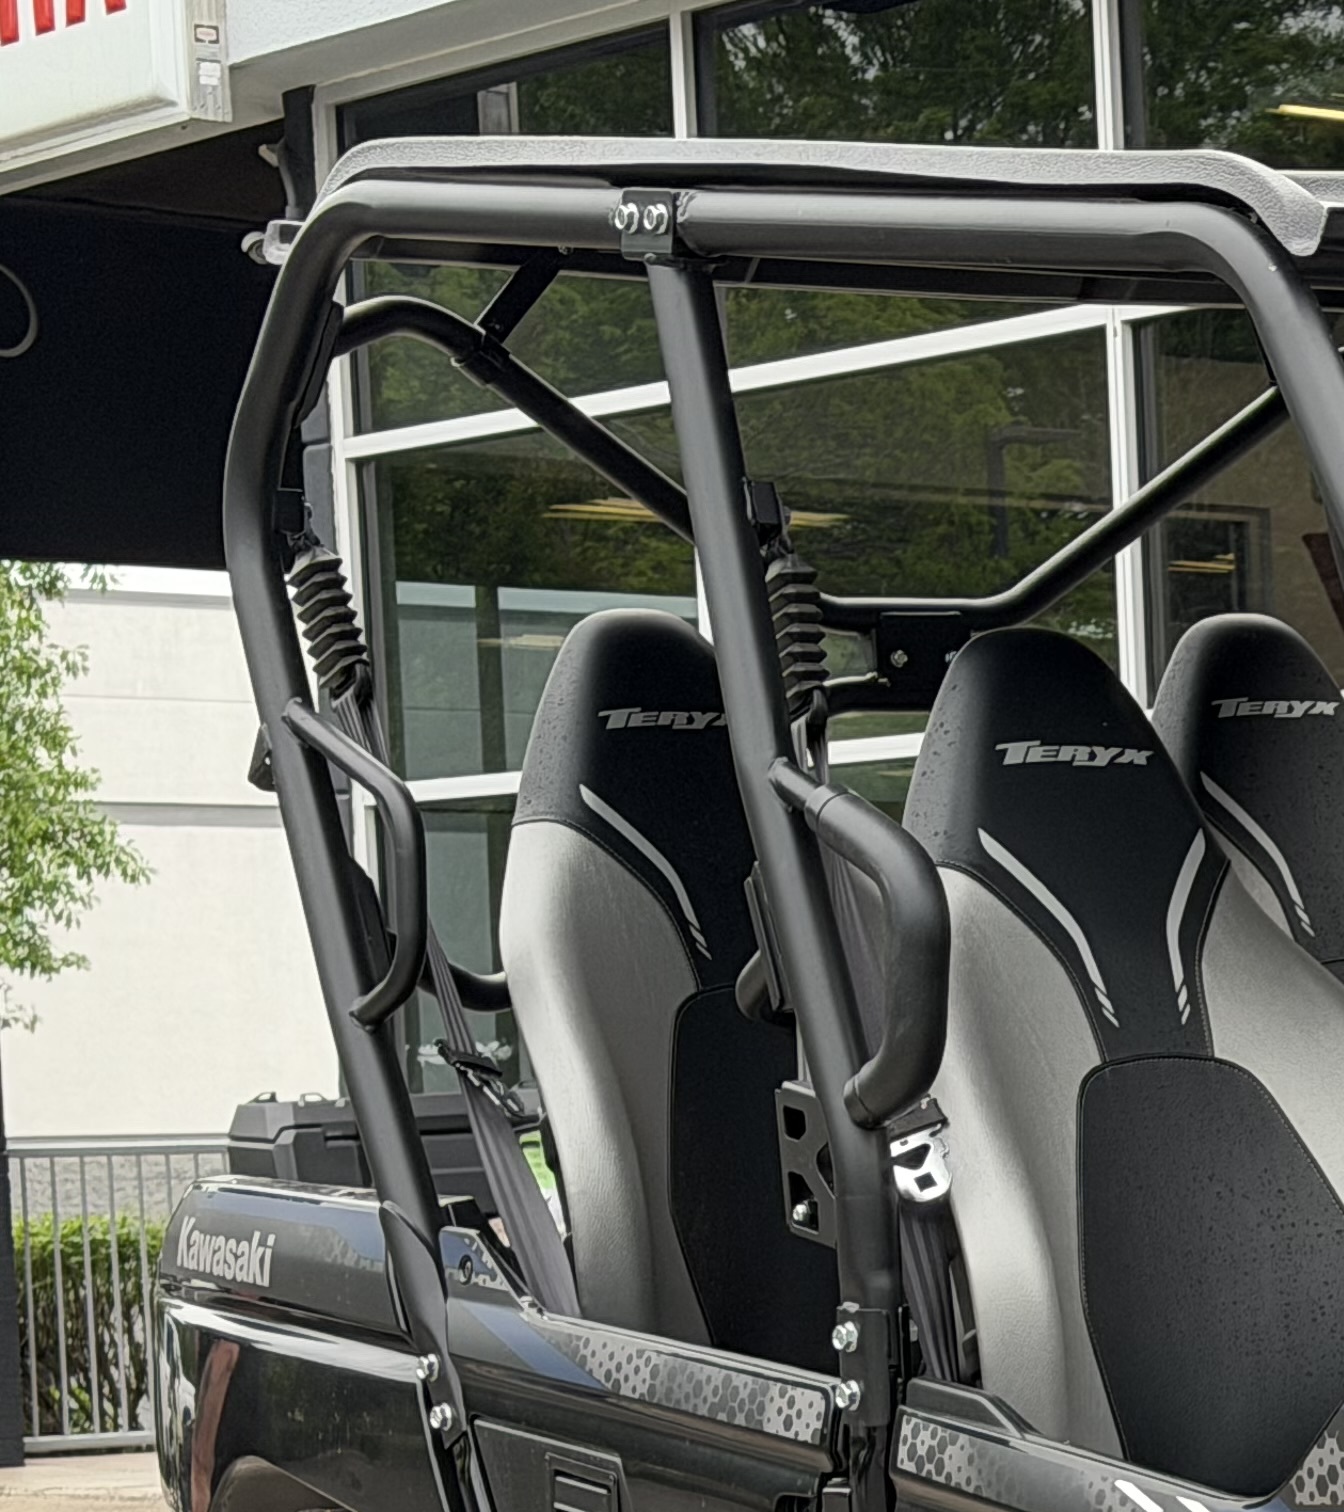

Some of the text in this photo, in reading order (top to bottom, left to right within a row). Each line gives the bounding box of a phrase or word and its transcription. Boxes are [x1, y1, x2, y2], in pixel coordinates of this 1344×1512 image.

[1211, 696, 1340, 718] TERYX
[995, 739, 1154, 767] TERYX
[175, 1215, 277, 1288] Kawasaki
